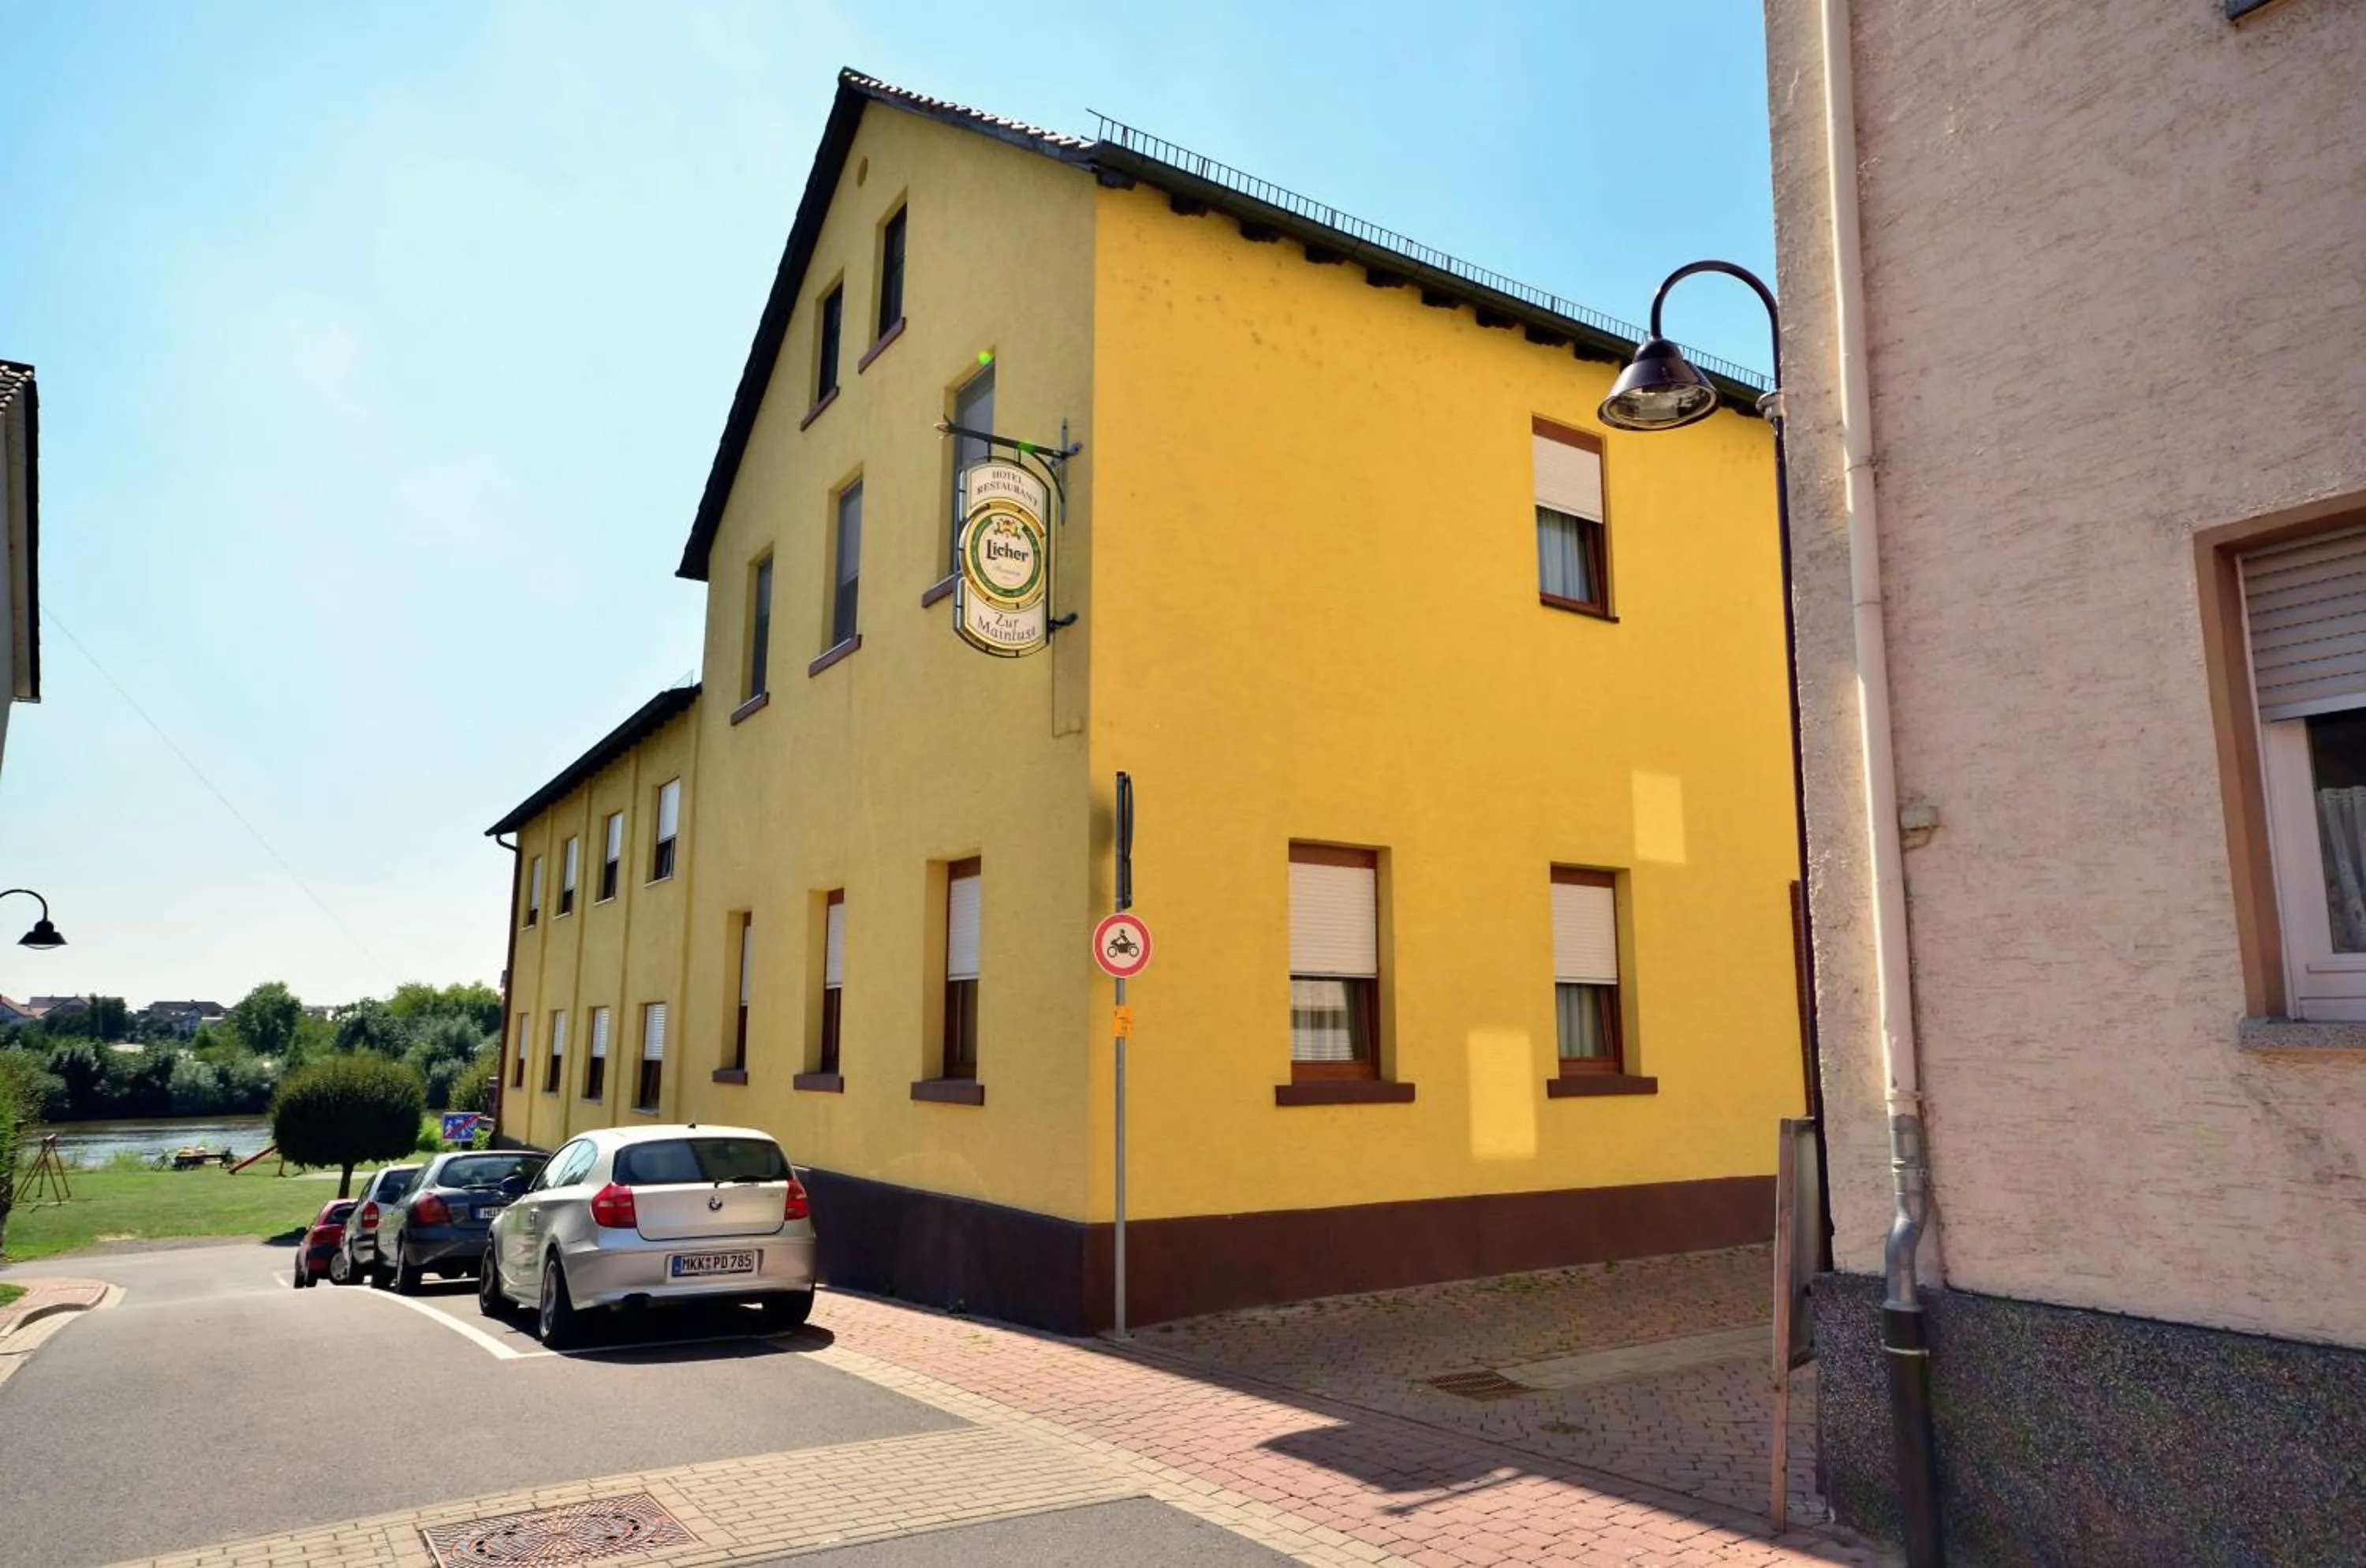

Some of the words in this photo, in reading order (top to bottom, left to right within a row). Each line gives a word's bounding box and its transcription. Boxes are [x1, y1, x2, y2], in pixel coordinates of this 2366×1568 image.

[992, 471, 1022, 483] HOTEL
[977, 482, 1038, 506] RESTAURANT
[986, 539, 1029, 562] Licher
[978, 615, 1036, 641] Mainlust
[995, 611, 1020, 628] Zur
[682, 1256, 705, 1271] MKK
[730, 1255, 752, 1267] 785
